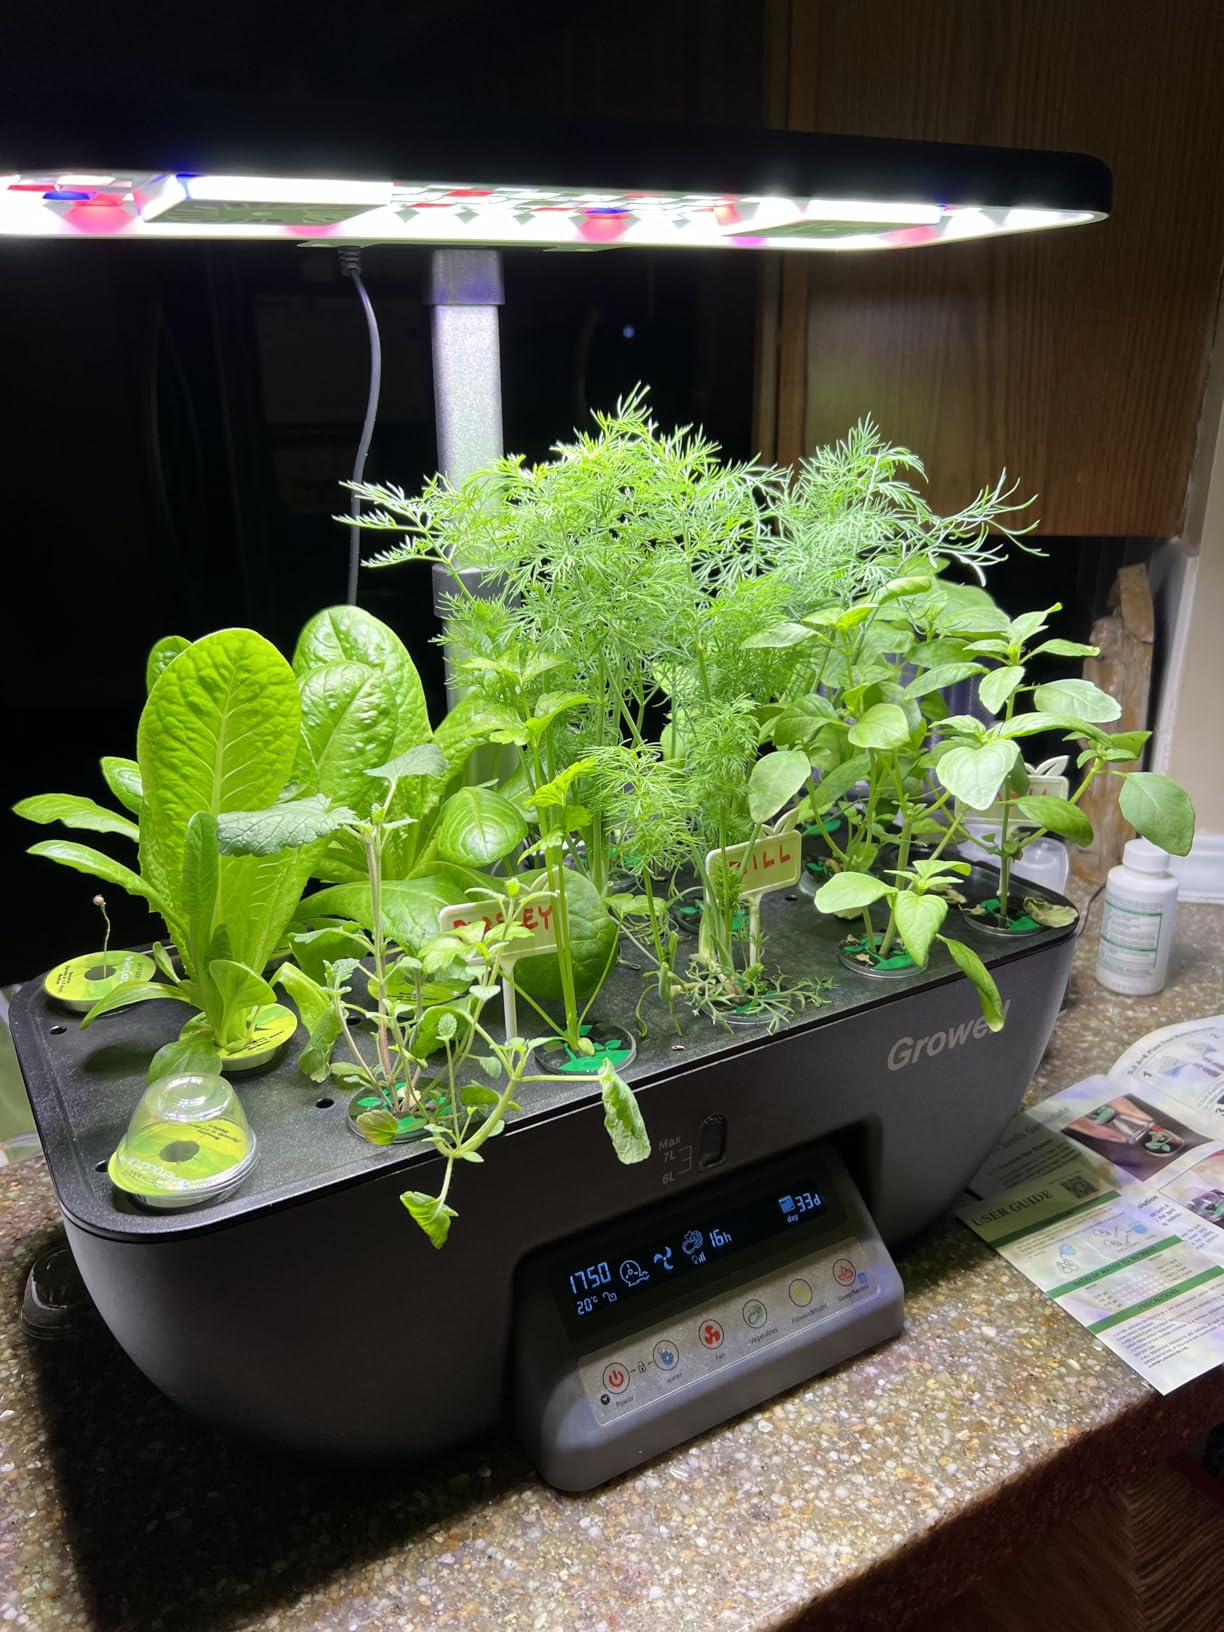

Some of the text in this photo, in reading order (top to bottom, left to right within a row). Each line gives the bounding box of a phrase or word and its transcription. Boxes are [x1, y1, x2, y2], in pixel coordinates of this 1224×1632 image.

[658, 1136, 681, 1151] Max
[663, 1150, 676, 1164] 7L
[662, 1171, 676, 1185] 6L
[970, 1189, 1054, 1226] USER GUIDE
[787, 1213, 799, 1223] day
[709, 1229, 732, 1248] 16h
[569, 1261, 611, 1294] 1750
[750, 1327, 779, 1344] Vegetables
[715, 1352, 726, 1361] Fan
[667, 1372, 683, 1384] water
[616, 1396, 634, 1408] Power
